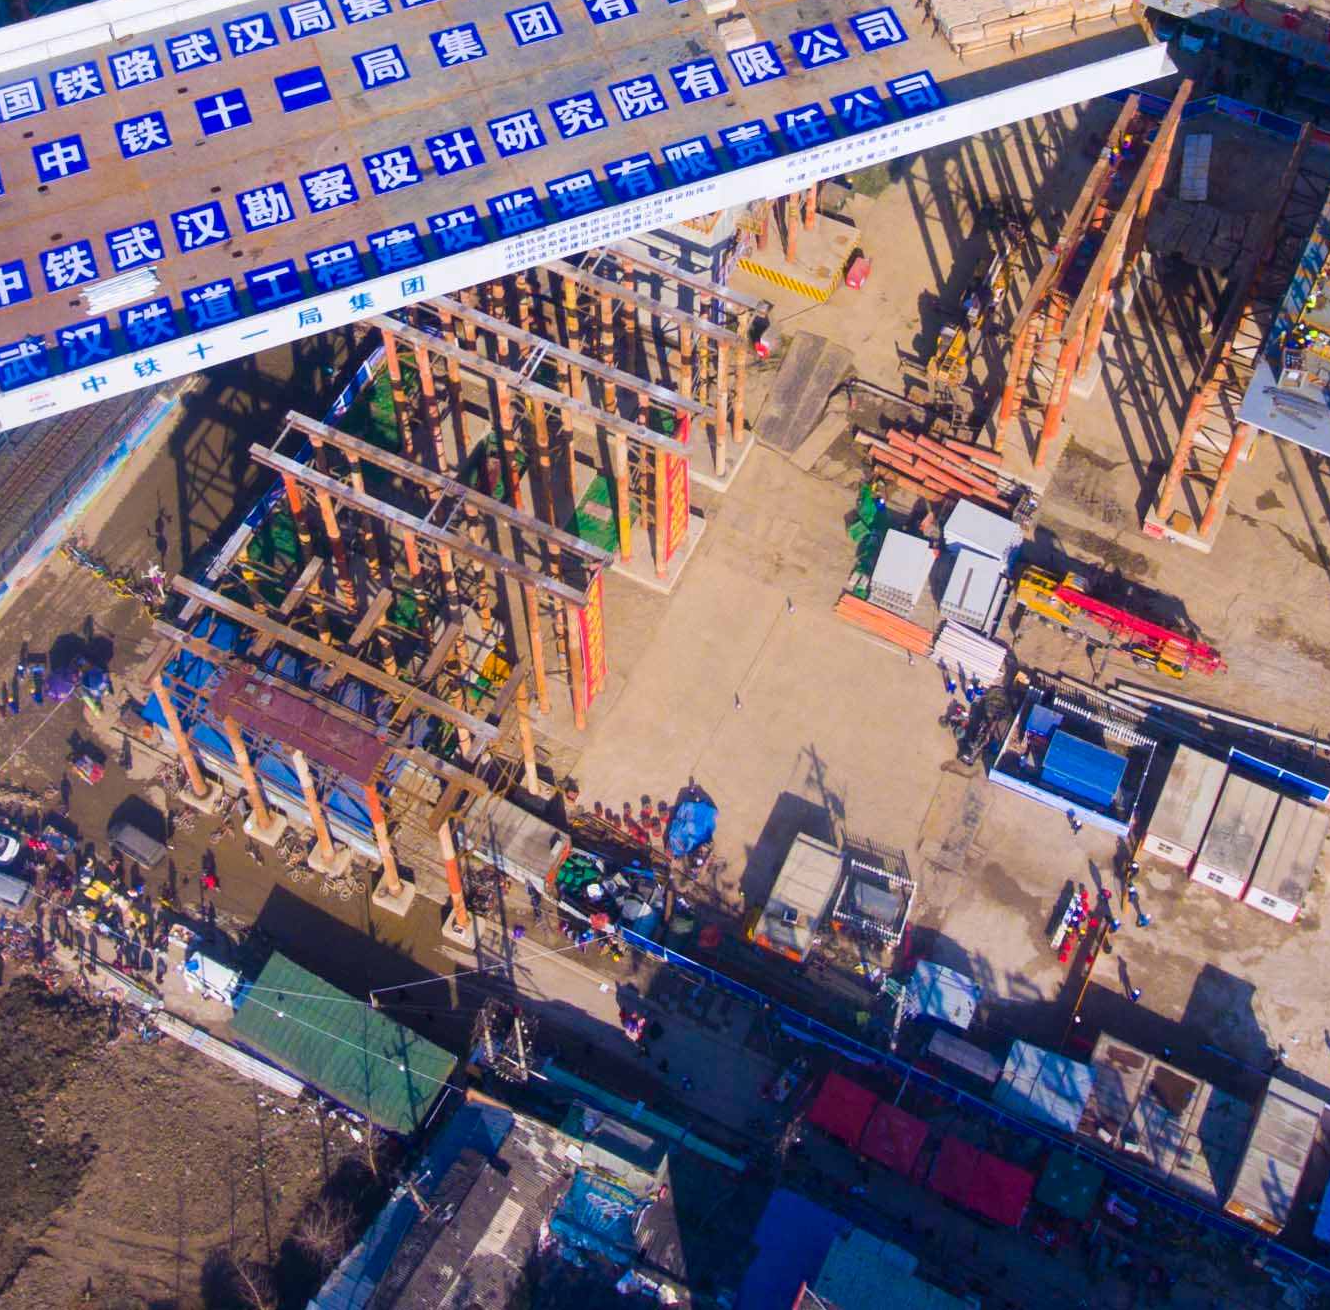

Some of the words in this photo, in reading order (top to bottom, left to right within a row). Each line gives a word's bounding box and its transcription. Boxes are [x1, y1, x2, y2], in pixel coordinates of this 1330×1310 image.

[0, 74, 939, 387] 武汉铁道工程建设监理有限责任公司
[81, 275, 426, 394] 中铁十一局集团
